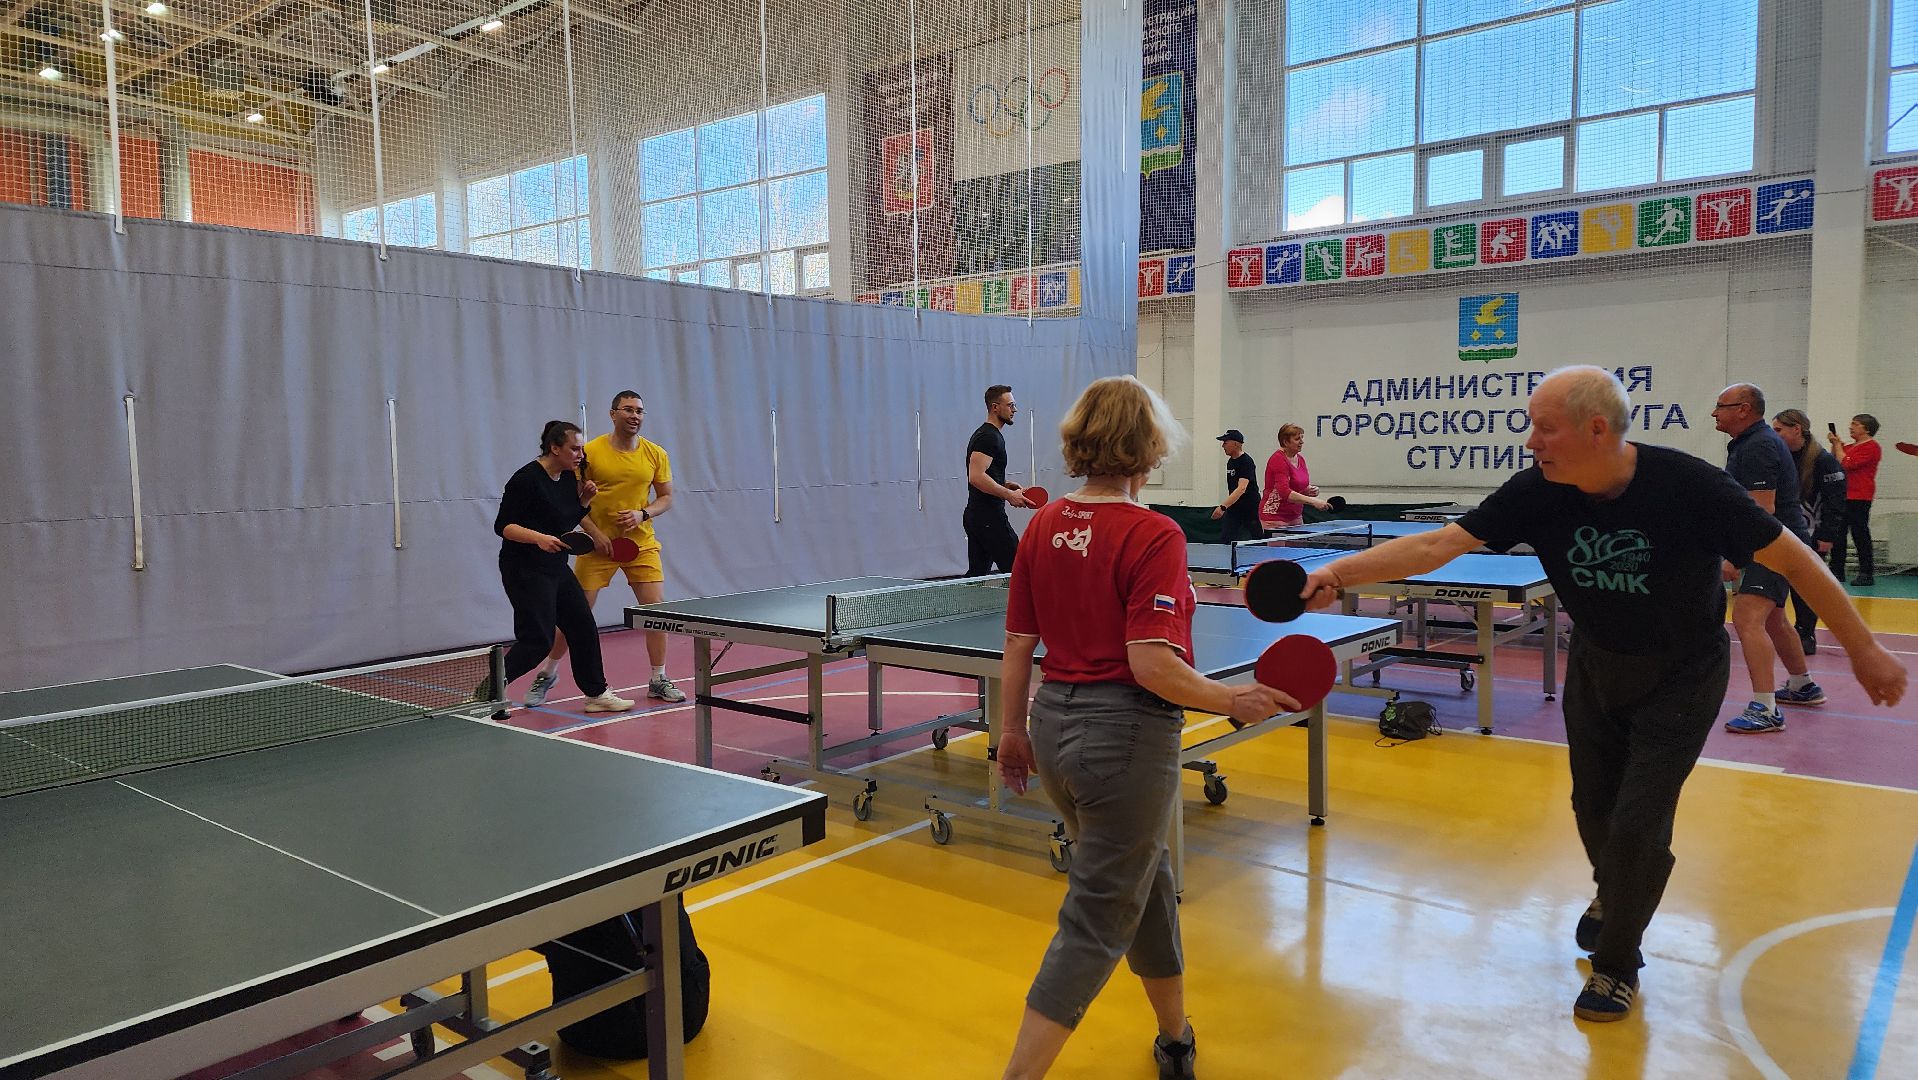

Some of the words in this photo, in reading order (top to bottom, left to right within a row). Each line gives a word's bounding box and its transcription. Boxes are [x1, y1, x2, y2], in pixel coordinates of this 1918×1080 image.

[1144, 40, 1167, 53] РУГА
[1144, 50, 1172, 65] ПИНО
[1341, 365, 1653, 407] АДМИНИСТРИЯ
[1316, 408, 1532, 440] ГОРОДСКОГО
[1406, 445, 1534, 470] СТУПИН
[1571, 566, 1651, 595] СМК
[1434, 588, 1492, 599] DONIC
[643, 619, 685, 633] DONIC
[1360, 635, 1391, 654] DONIC
[662, 837, 776, 894] DONIC
